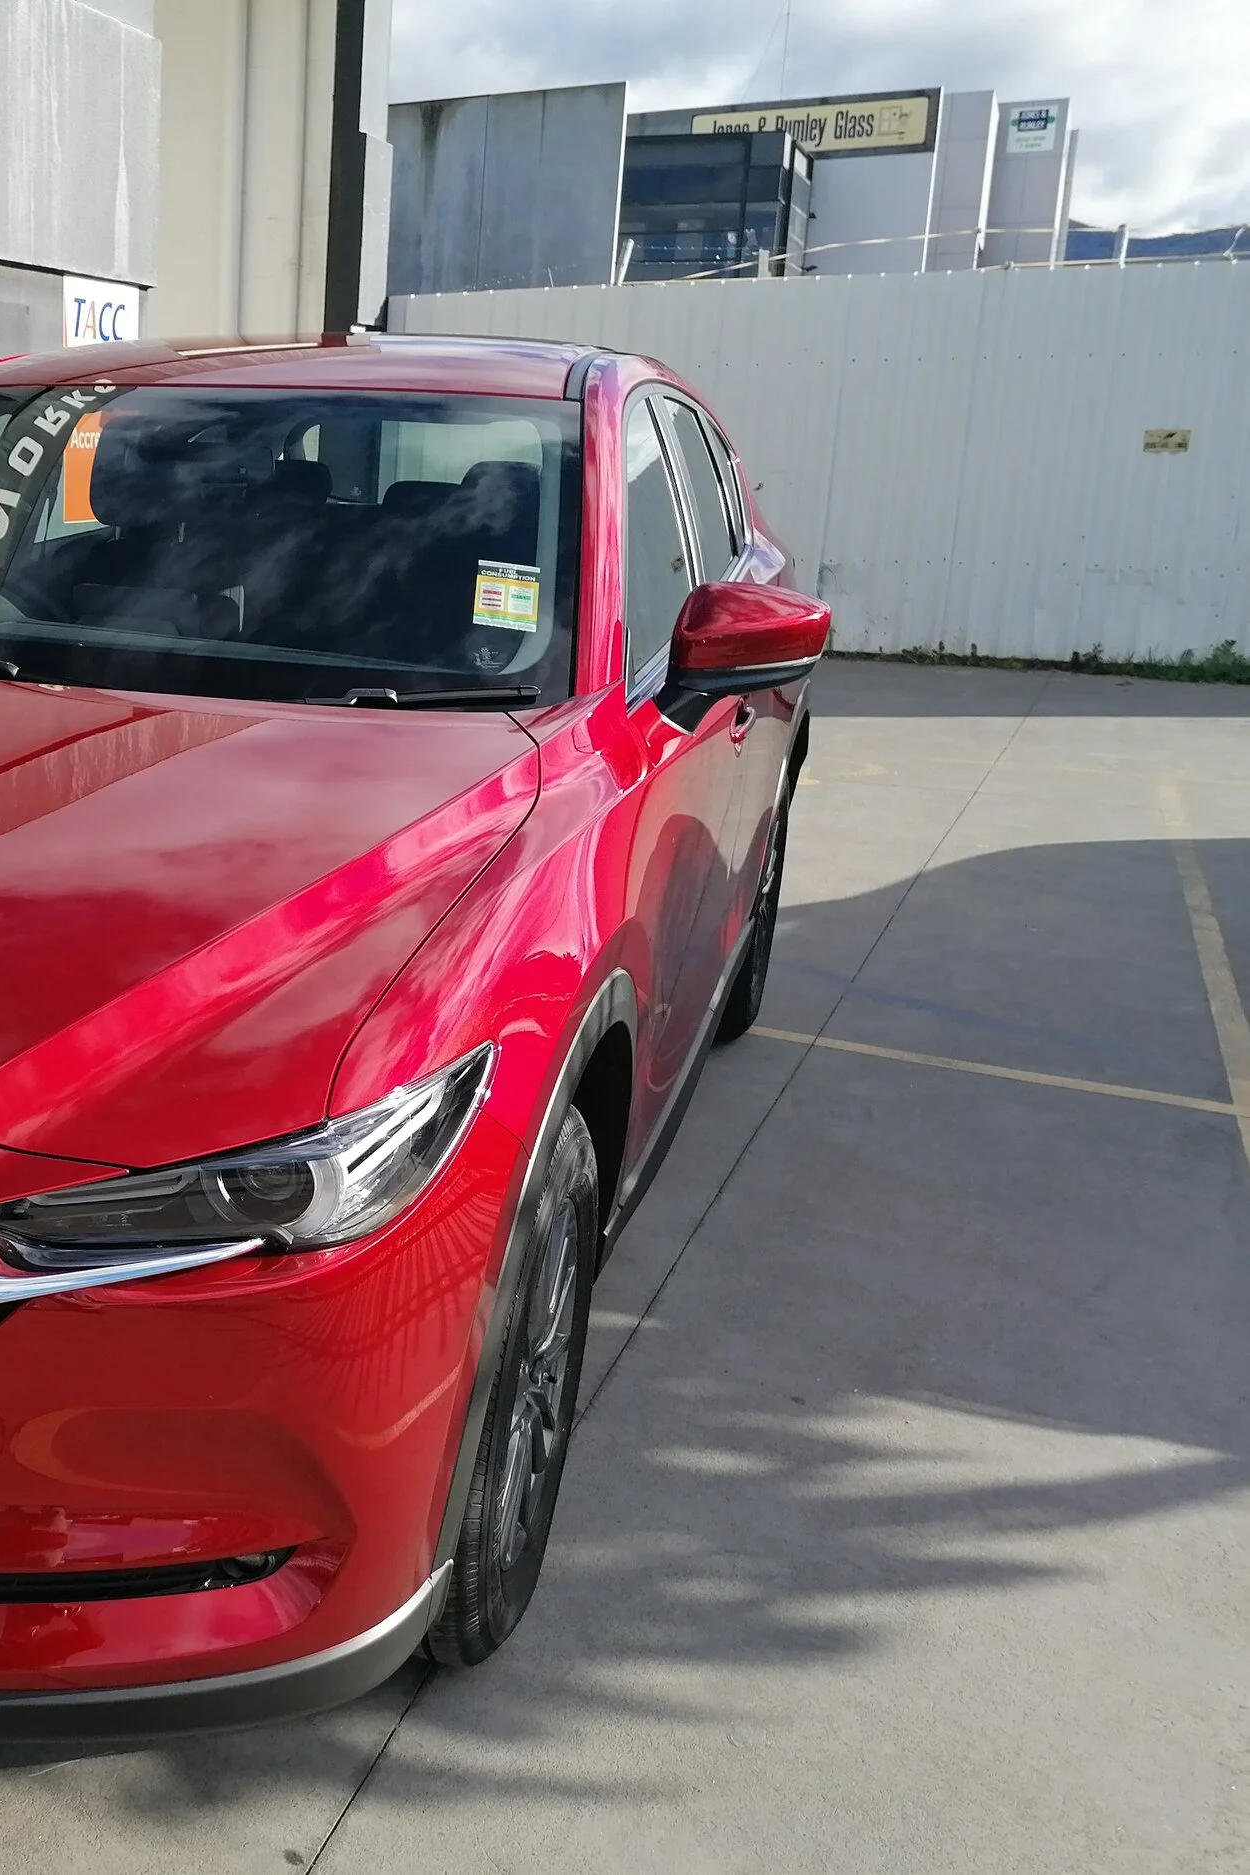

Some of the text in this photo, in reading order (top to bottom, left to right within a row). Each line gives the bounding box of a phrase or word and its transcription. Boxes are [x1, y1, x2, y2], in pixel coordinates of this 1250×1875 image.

[834, 111, 875, 140] Glass
[74, 298, 126, 342] TACC
[481, 569, 536, 582] CONSUMPTION
[499, 567, 518, 575] FUEL
